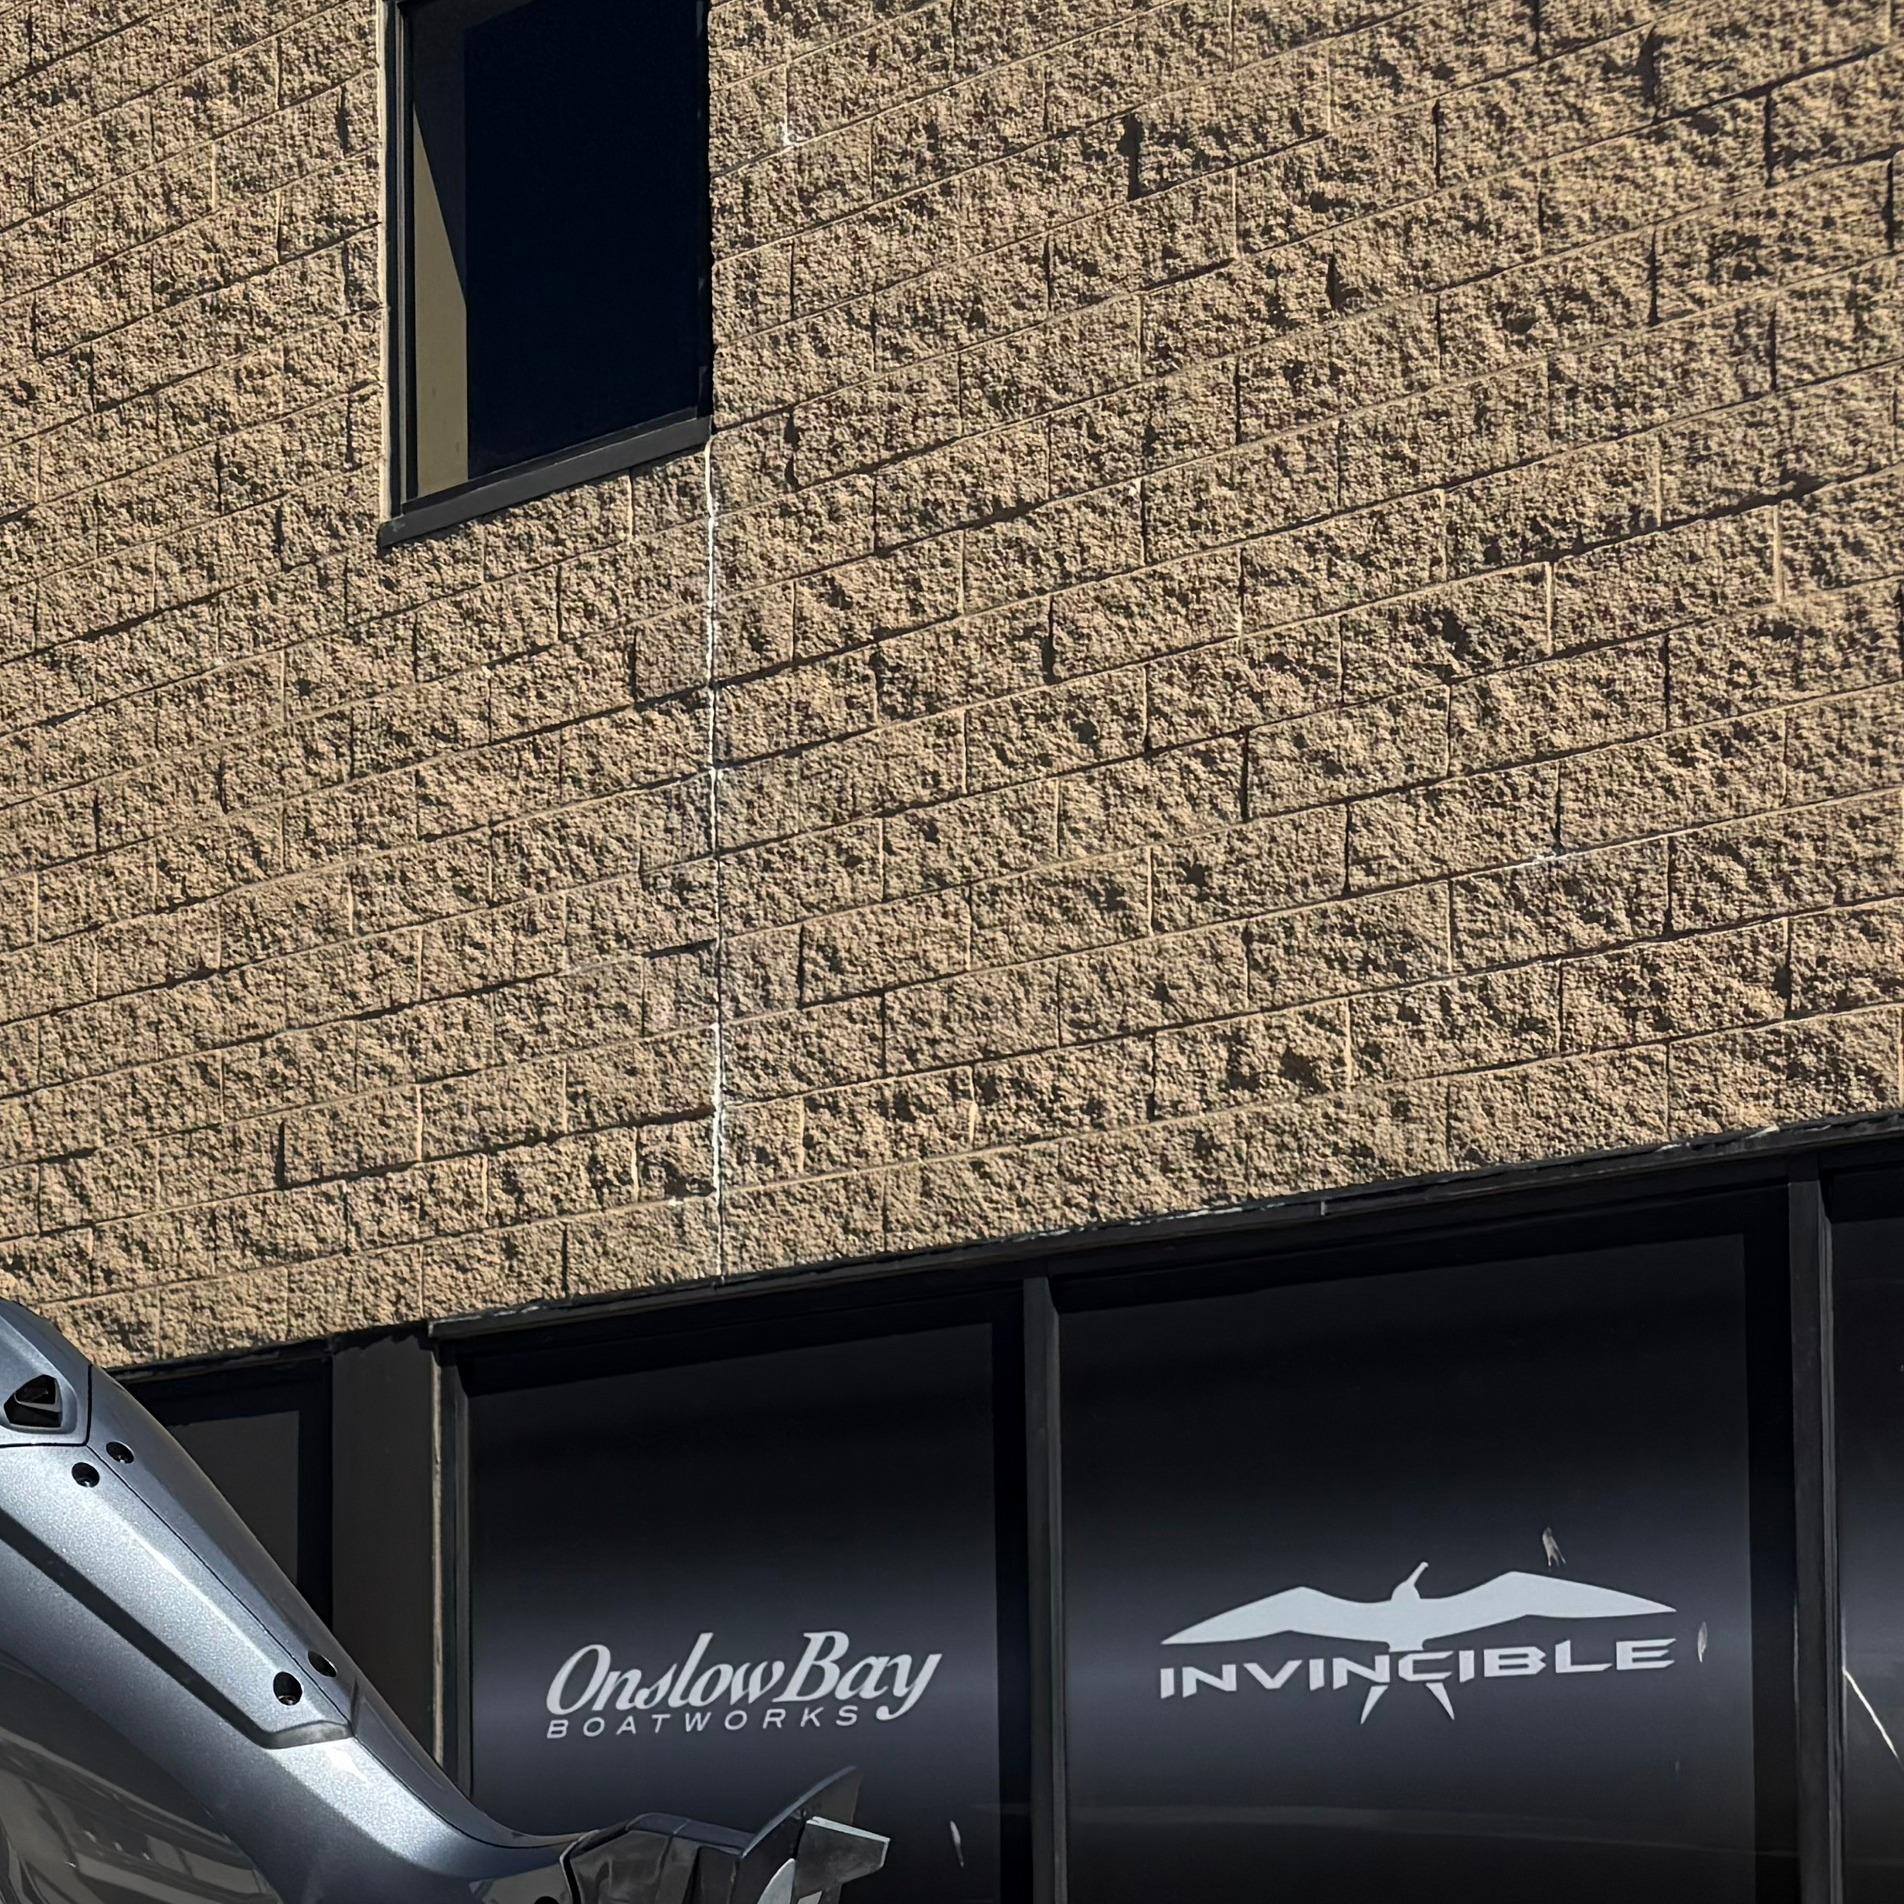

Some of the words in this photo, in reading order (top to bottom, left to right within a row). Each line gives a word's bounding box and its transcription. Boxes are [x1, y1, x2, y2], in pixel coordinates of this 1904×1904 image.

[545, 1631, 786, 1716] Onslow
[773, 1629, 943, 1722] Bay
[1159, 1637, 1677, 1700] INVINCIBLE
[545, 1703, 860, 1740] BOATWORKS
